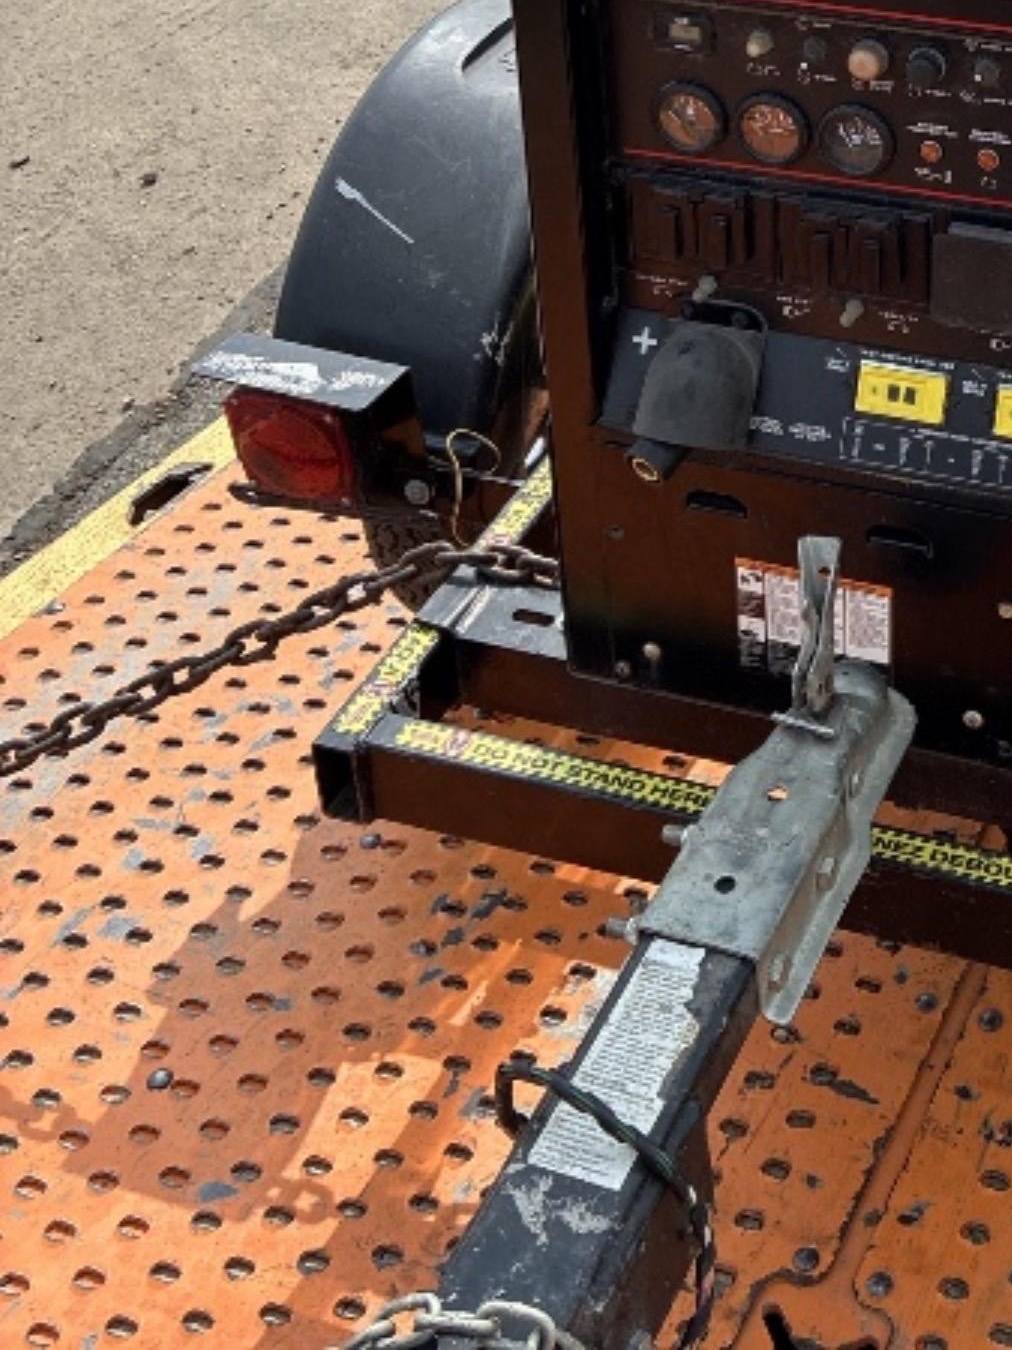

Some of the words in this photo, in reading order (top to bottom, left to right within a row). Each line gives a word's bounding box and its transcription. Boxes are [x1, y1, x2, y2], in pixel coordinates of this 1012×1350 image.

[472, 743, 509, 762] DO
[512, 752, 562, 772] NOT
[567, 763, 647, 792] STAND
